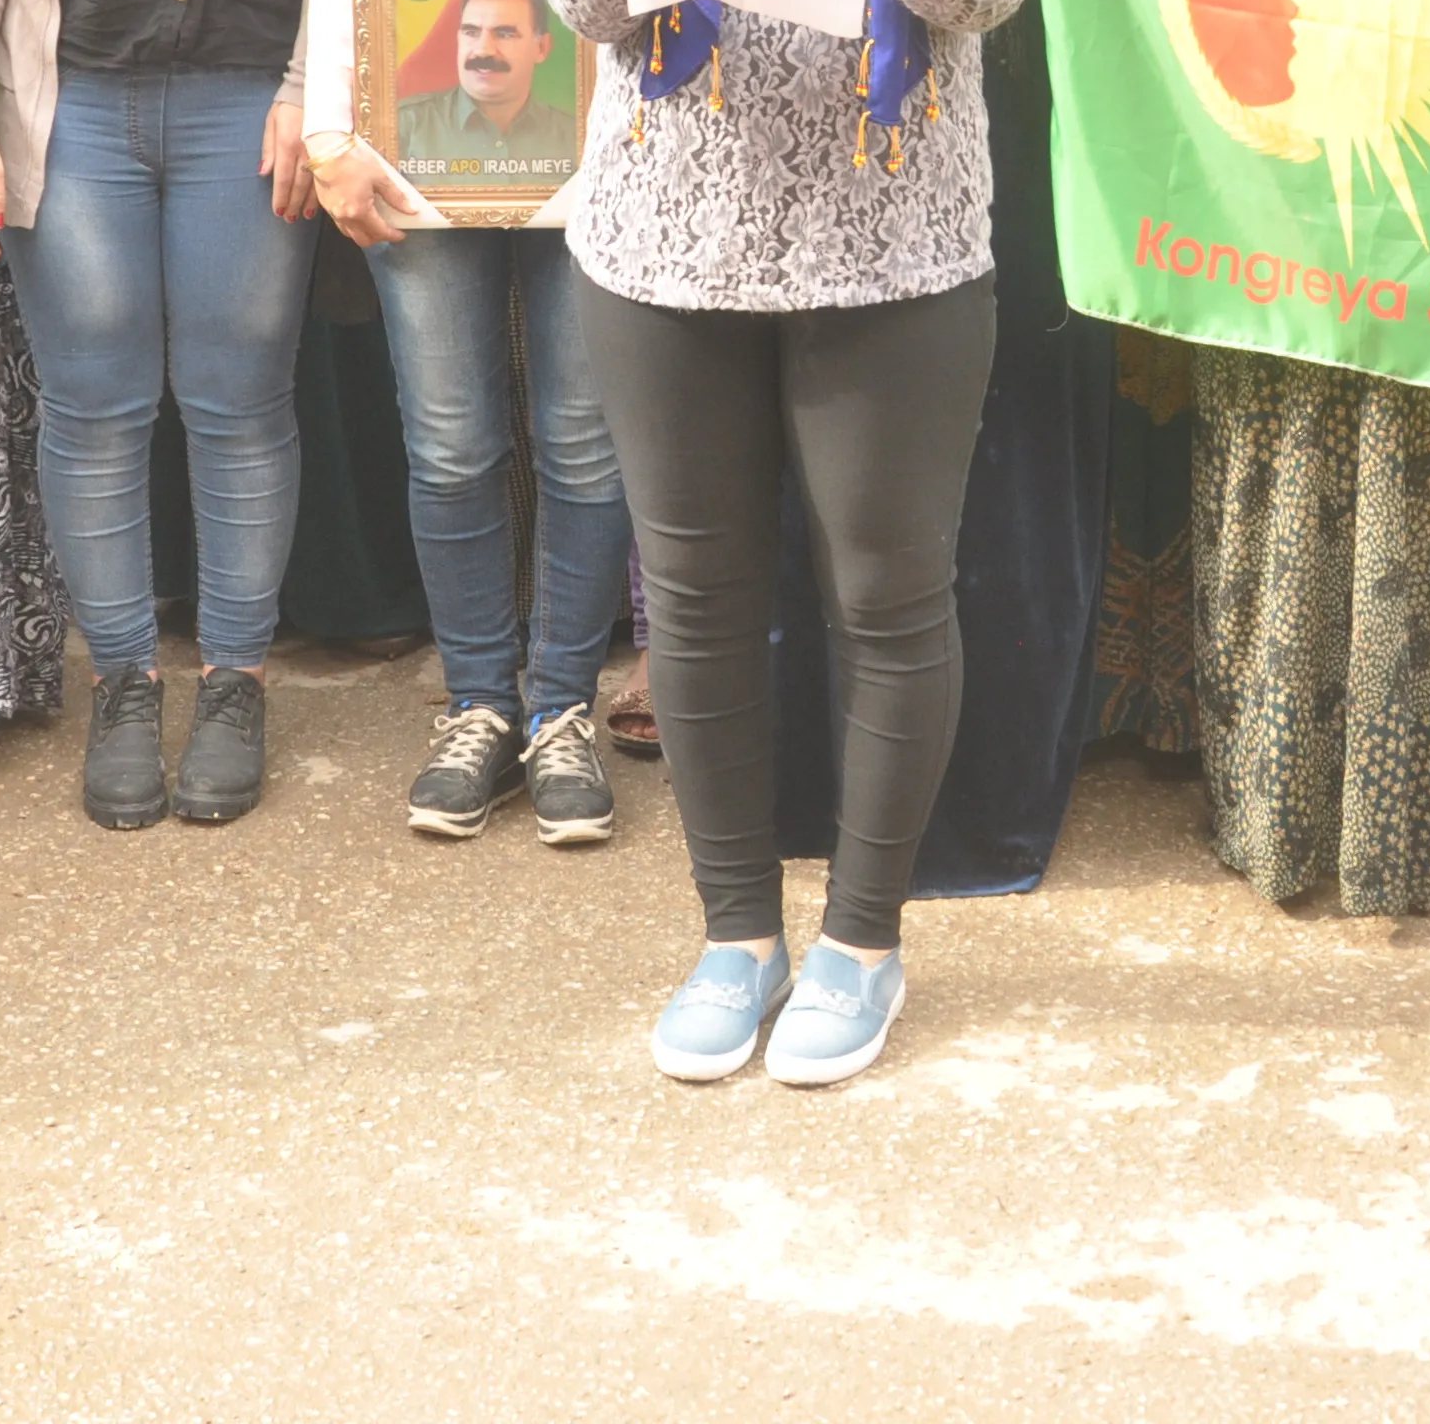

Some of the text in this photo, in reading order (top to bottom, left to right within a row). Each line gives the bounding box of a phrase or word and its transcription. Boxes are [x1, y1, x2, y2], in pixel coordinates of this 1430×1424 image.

[398, 156, 572, 174] RÊBER APO IRADA MEYE
[1135, 216, 1409, 323] Kongreya
